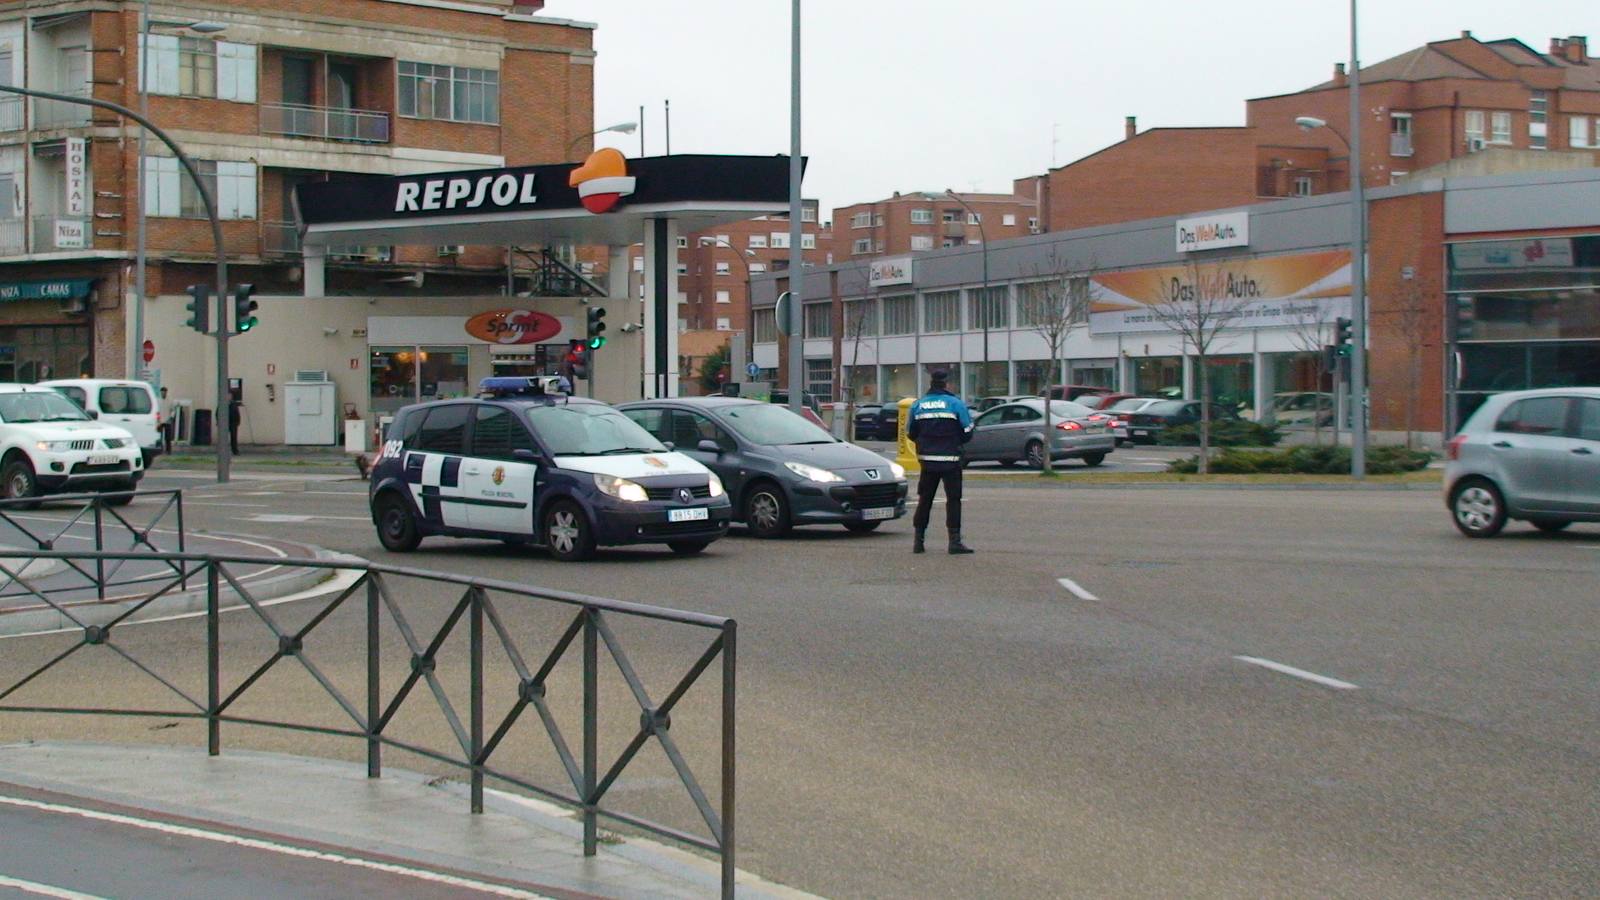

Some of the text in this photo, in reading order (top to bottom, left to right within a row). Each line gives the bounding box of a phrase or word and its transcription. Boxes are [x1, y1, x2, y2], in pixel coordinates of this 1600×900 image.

[71, 143, 82, 212] HOSTAL
[394, 173, 537, 212] REPSOL
[59, 225, 81, 237] Niza
[1180, 227, 1195, 244] Das
[1, 283, 70, 298] NIZA CAMAS
[1171, 276, 1194, 301] Das
[487, 319, 540, 337] Sprint
[383, 440, 403, 459] 092
